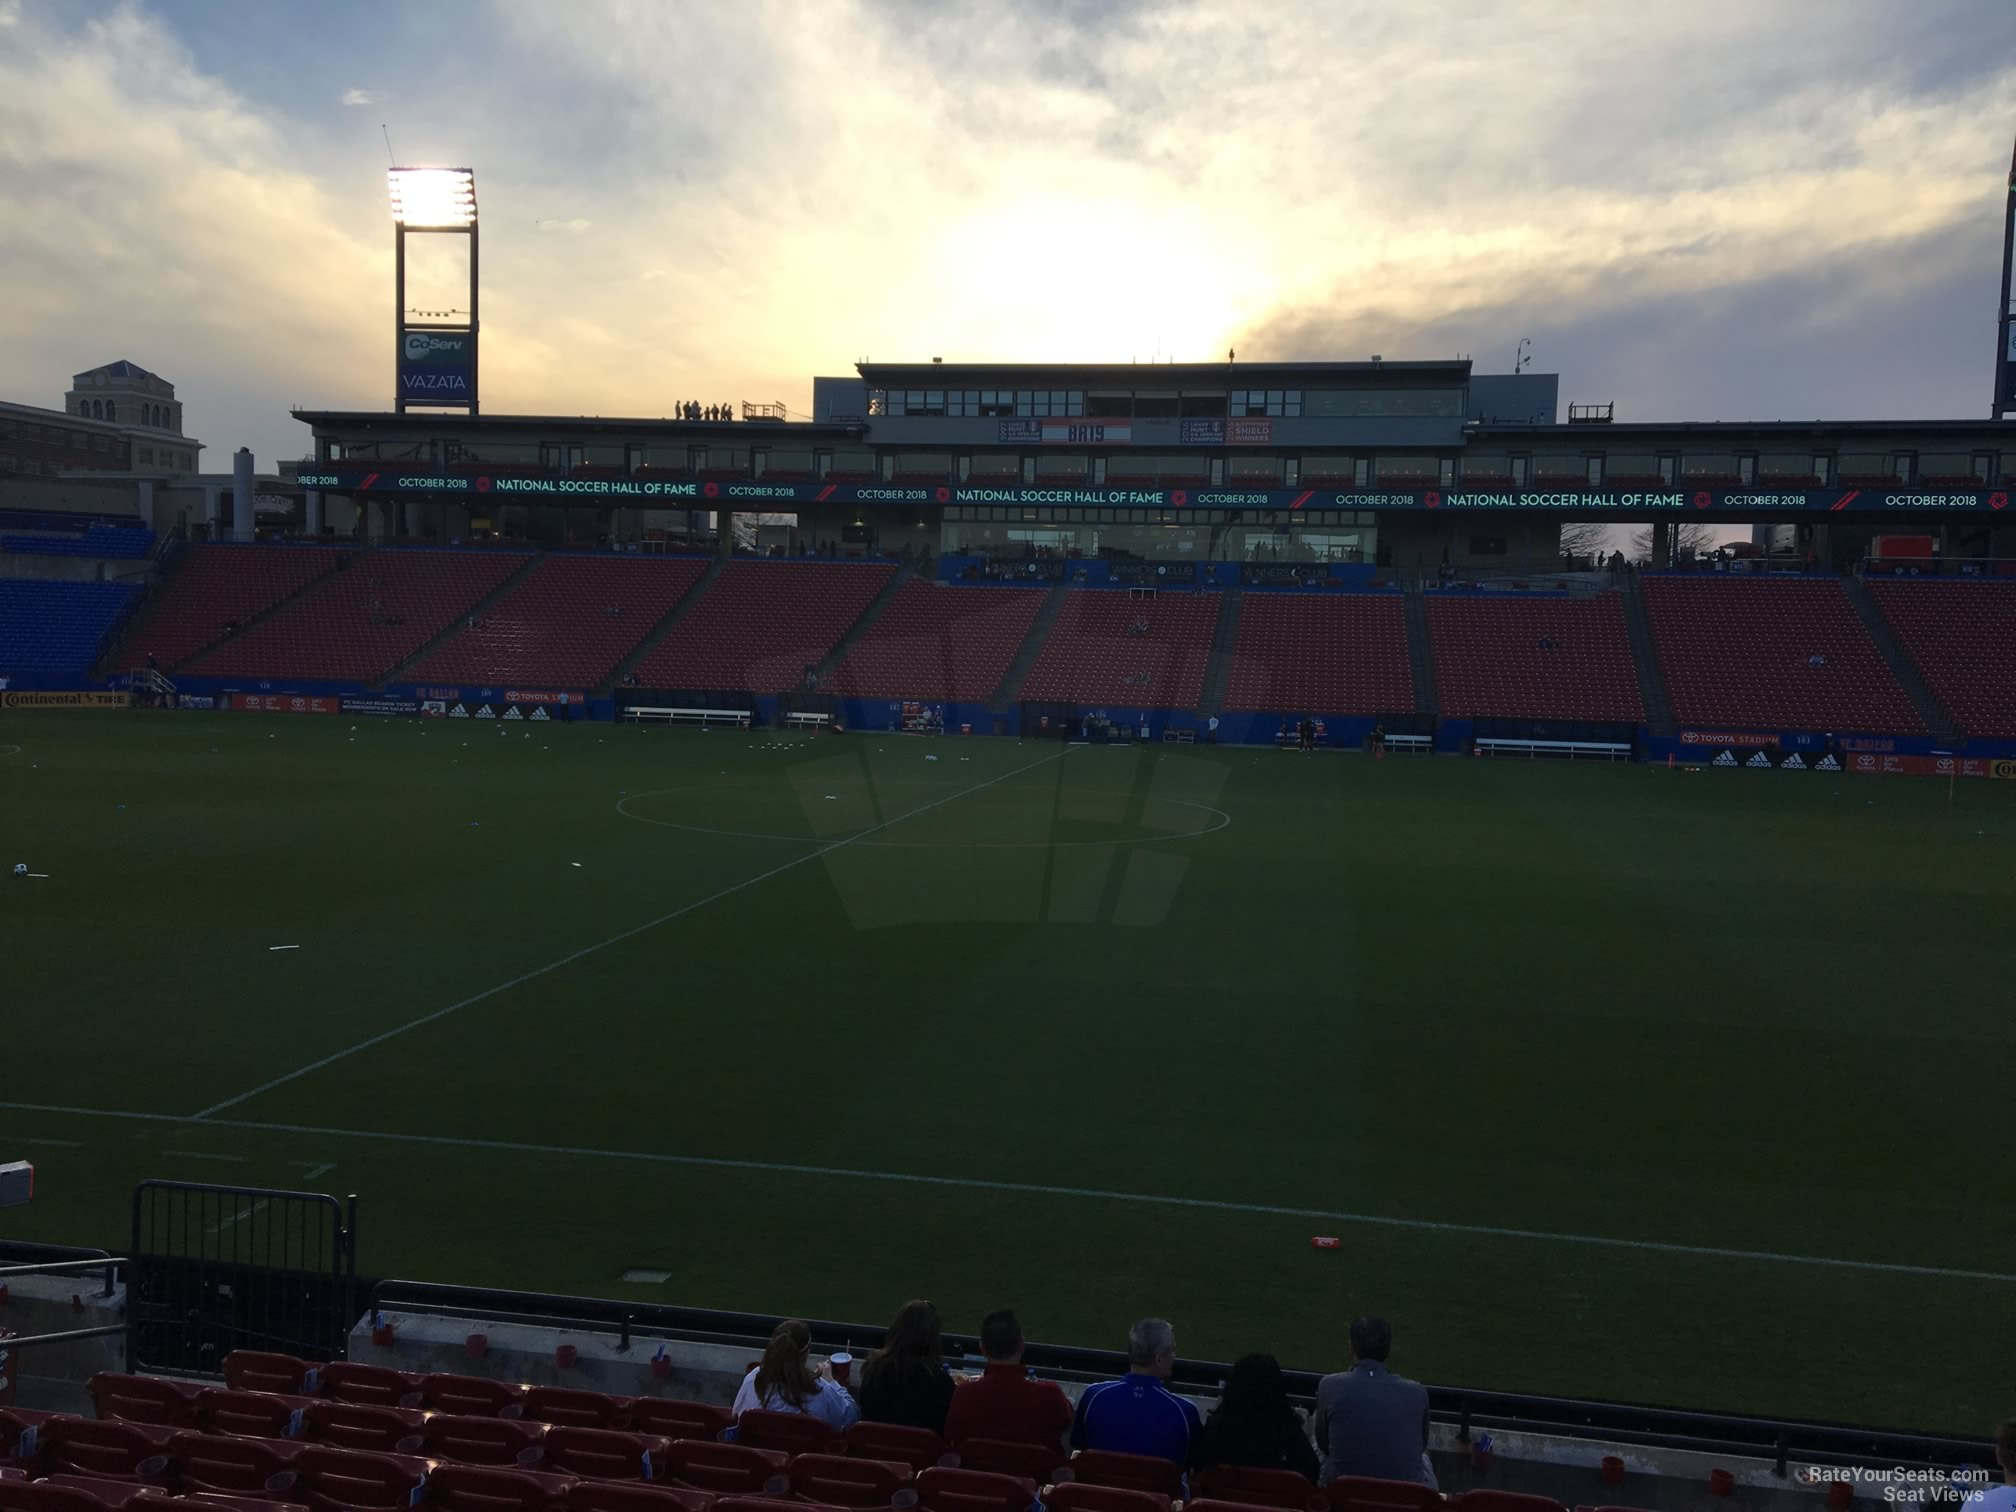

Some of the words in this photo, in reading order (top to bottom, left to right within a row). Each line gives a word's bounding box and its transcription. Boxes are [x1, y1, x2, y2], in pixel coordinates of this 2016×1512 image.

[410, 338, 463, 350] CoServ
[403, 375, 466, 389] VAZATA
[1235, 426, 1270, 435] SHIELD
[319, 476, 338, 485] 2018
[398, 477, 445, 488] OCTOBER
[447, 479, 467, 488] 2018
[496, 479, 556, 492] NATIONAL
[559, 480, 608, 493] SOCCER
[611, 481, 641, 494] HALL
[644, 482, 661, 494] OF
[664, 483, 697, 495] FAME
[728, 486, 773, 496] OCTOBER
[774, 487, 795, 497] 2018
[857, 489, 904, 500] OCTOBER
[906, 490, 927, 500] 2018
[956, 489, 1018, 502] NATIONAL
[1021, 490, 1071, 503] SOCCER
[1075, 491, 1106, 503] HALL
[1109, 491, 1127, 503] OF
[1130, 492, 1163, 503] FAME
[1197, 494, 1245, 504] OCTOBER
[1247, 494, 1268, 504] 2018
[1336, 495, 1388, 505] OCTOBER
[1390, 495, 1414, 505] 2018
[1447, 494, 1517, 506] NATIONAL
[1519, 494, 1578, 506] SOCCER
[1581, 494, 1617, 506] HALL
[1621, 494, 1642, 506] OF
[1645, 494, 1684, 506] FAME
[1724, 495, 1779, 505] OCTOBER
[1781, 495, 1806, 505] 2018
[1885, 495, 1946, 506] OCTOBER
[1949, 495, 1977, 506] 2018
[1167, 566, 1193, 575] CLUB
[5, 693, 82, 707] Continental
[96, 696, 125, 704] TIRE
[520, 693, 549, 701] TOYOTA
[1700, 734, 1735, 743] TOYOTA
